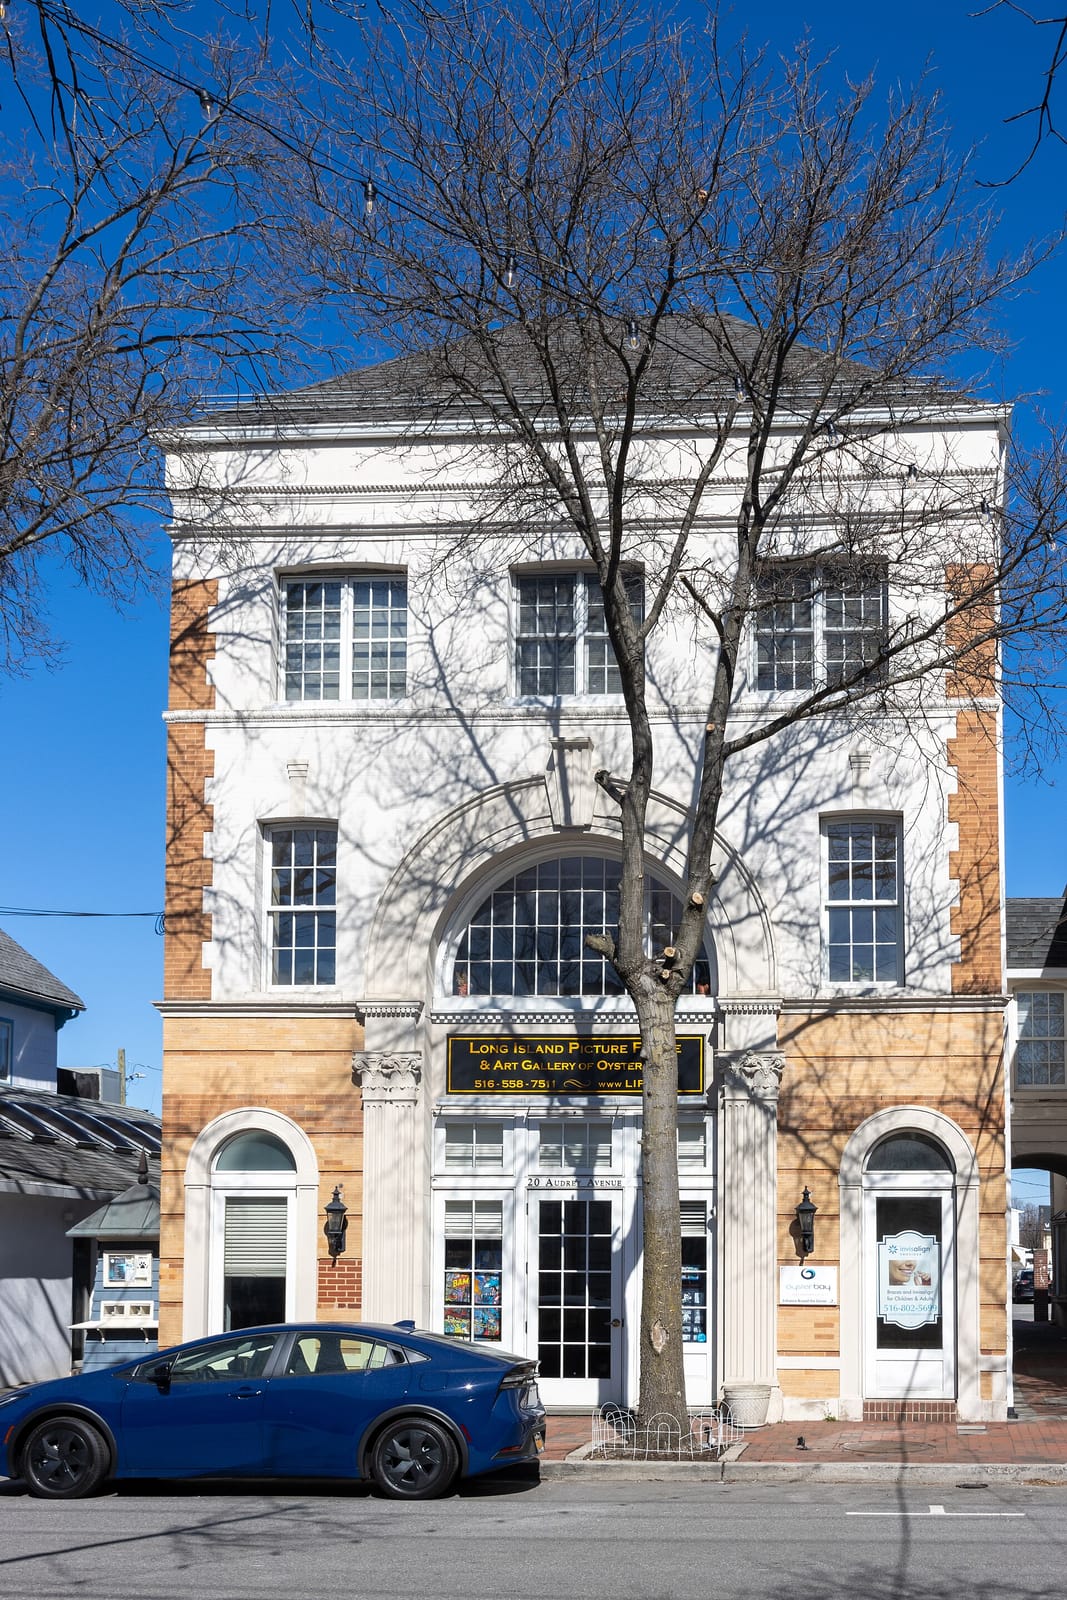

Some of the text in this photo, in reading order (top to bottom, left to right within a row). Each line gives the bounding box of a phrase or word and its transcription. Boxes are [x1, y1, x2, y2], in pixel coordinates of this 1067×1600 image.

[469, 1042, 509, 1054] LONG
[513, 1042, 564, 1054] ISLAND
[568, 1042, 628, 1054] PICTURE
[480, 1060, 643, 1070] & ART GALLERY OF OYSTER
[527, 1178, 622, 1187] 20 AUDREY AVENUE
